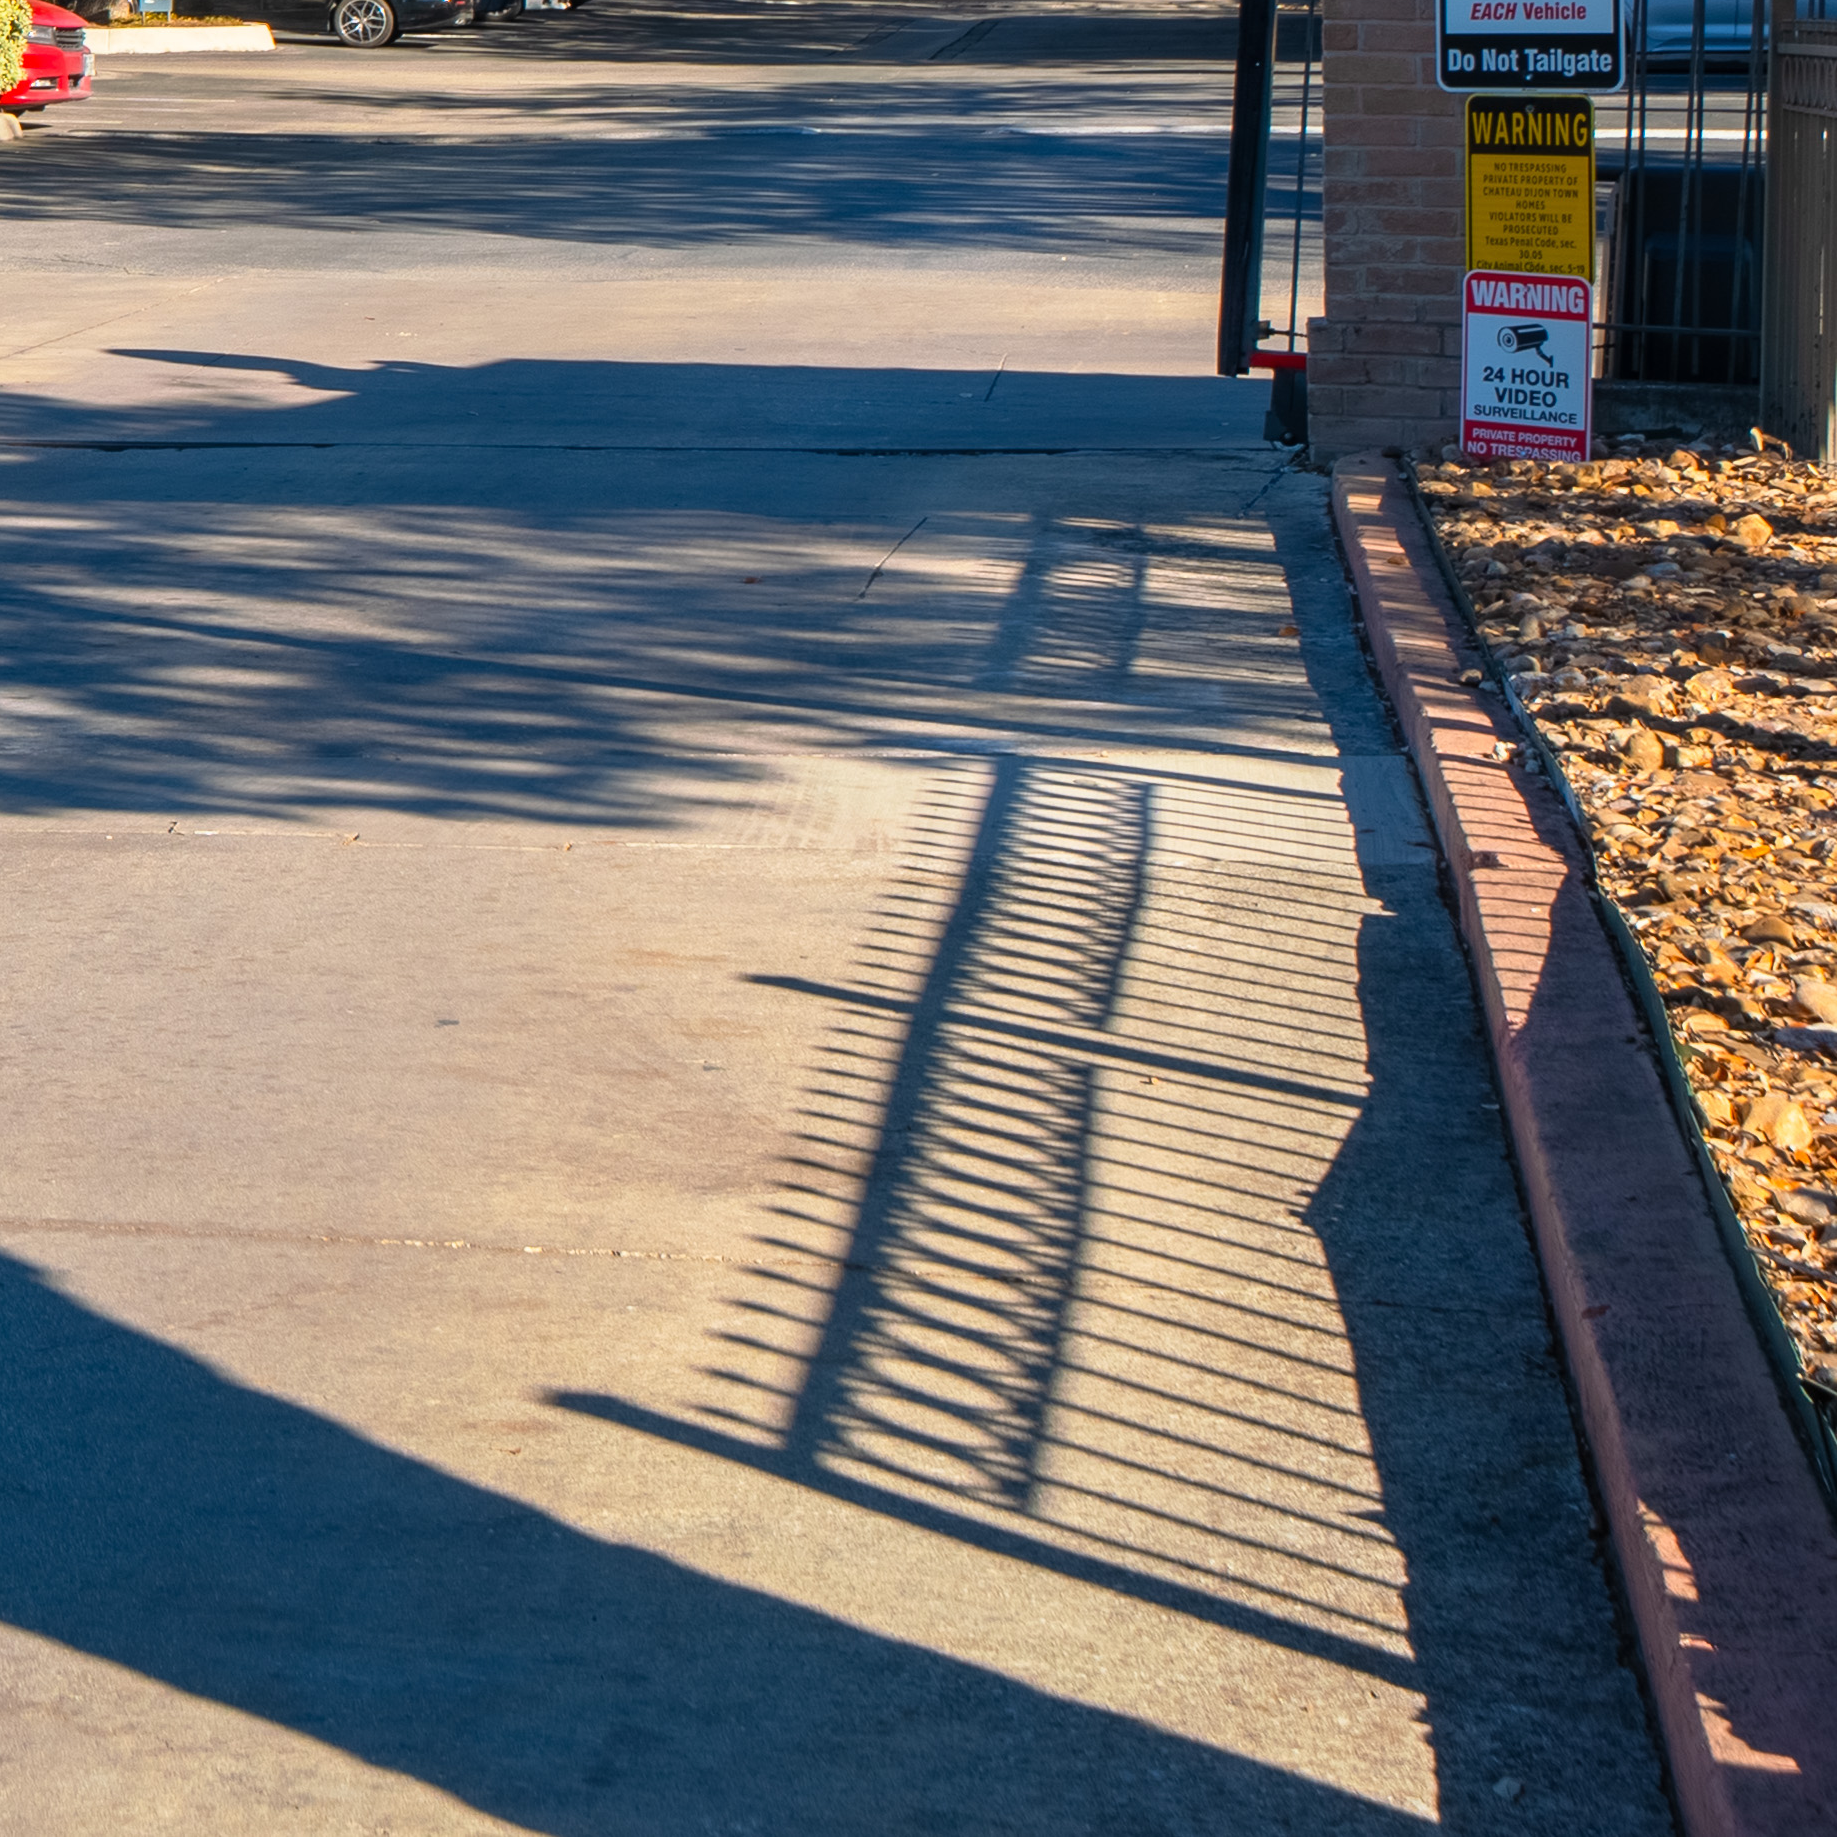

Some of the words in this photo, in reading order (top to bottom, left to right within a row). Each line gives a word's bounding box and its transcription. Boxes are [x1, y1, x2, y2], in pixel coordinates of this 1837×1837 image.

[1470, 3, 1517, 20] EACH
[1522, 2, 1587, 20] Vehicle
[1448, 49, 1475, 72] Do
[1482, 49, 1519, 72] Not
[1524, 48, 1613, 77] Tailgate
[1472, 111, 1588, 147] WARNING
[1494, 163, 1507, 172] NO
[1509, 163, 1567, 174] TRESPASSING
[1483, 175, 1518, 184] PRIVATE
[1520, 175, 1565, 186] PROPERTY
[1567, 176, 1578, 186] OF
[1483, 187, 1522, 197] CHATEAU
[1525, 187, 1551, 198] DIJON
[1553, 188, 1578, 198] TOWN
[1516, 200, 1546, 210] HOMES
[1489, 212, 1537, 222] VIOLATORS
[1539, 213, 1559, 223] WILL
[1561, 214, 1573, 223] BE
[1503, 224, 1559, 235] PROSECUTED
[1485, 236, 1508, 246] Texas
[1510, 237, 1533, 247] Penal
[1535, 238, 1559, 249] Code,
[1560, 241, 1577, 249] sec.
[1519, 250, 1543, 260] 30.05
[1477, 260, 1493, 271] City
[1495, 260, 1522, 271] Animal
[1471, 279, 1585, 314] WARNING
[1483, 366, 1505, 383] 24
[1511, 368, 1569, 389] HOUR
[1494, 387, 1557, 408] VIDEO
[1473, 404, 1577, 425] SURVEILLANCE
[1472, 427, 1516, 442] PRIVATE
[1518, 431, 1577, 448] PROPERTY
[1467, 440, 1487, 455] NO
[1491, 443, 1581, 462] TRESPASSING
